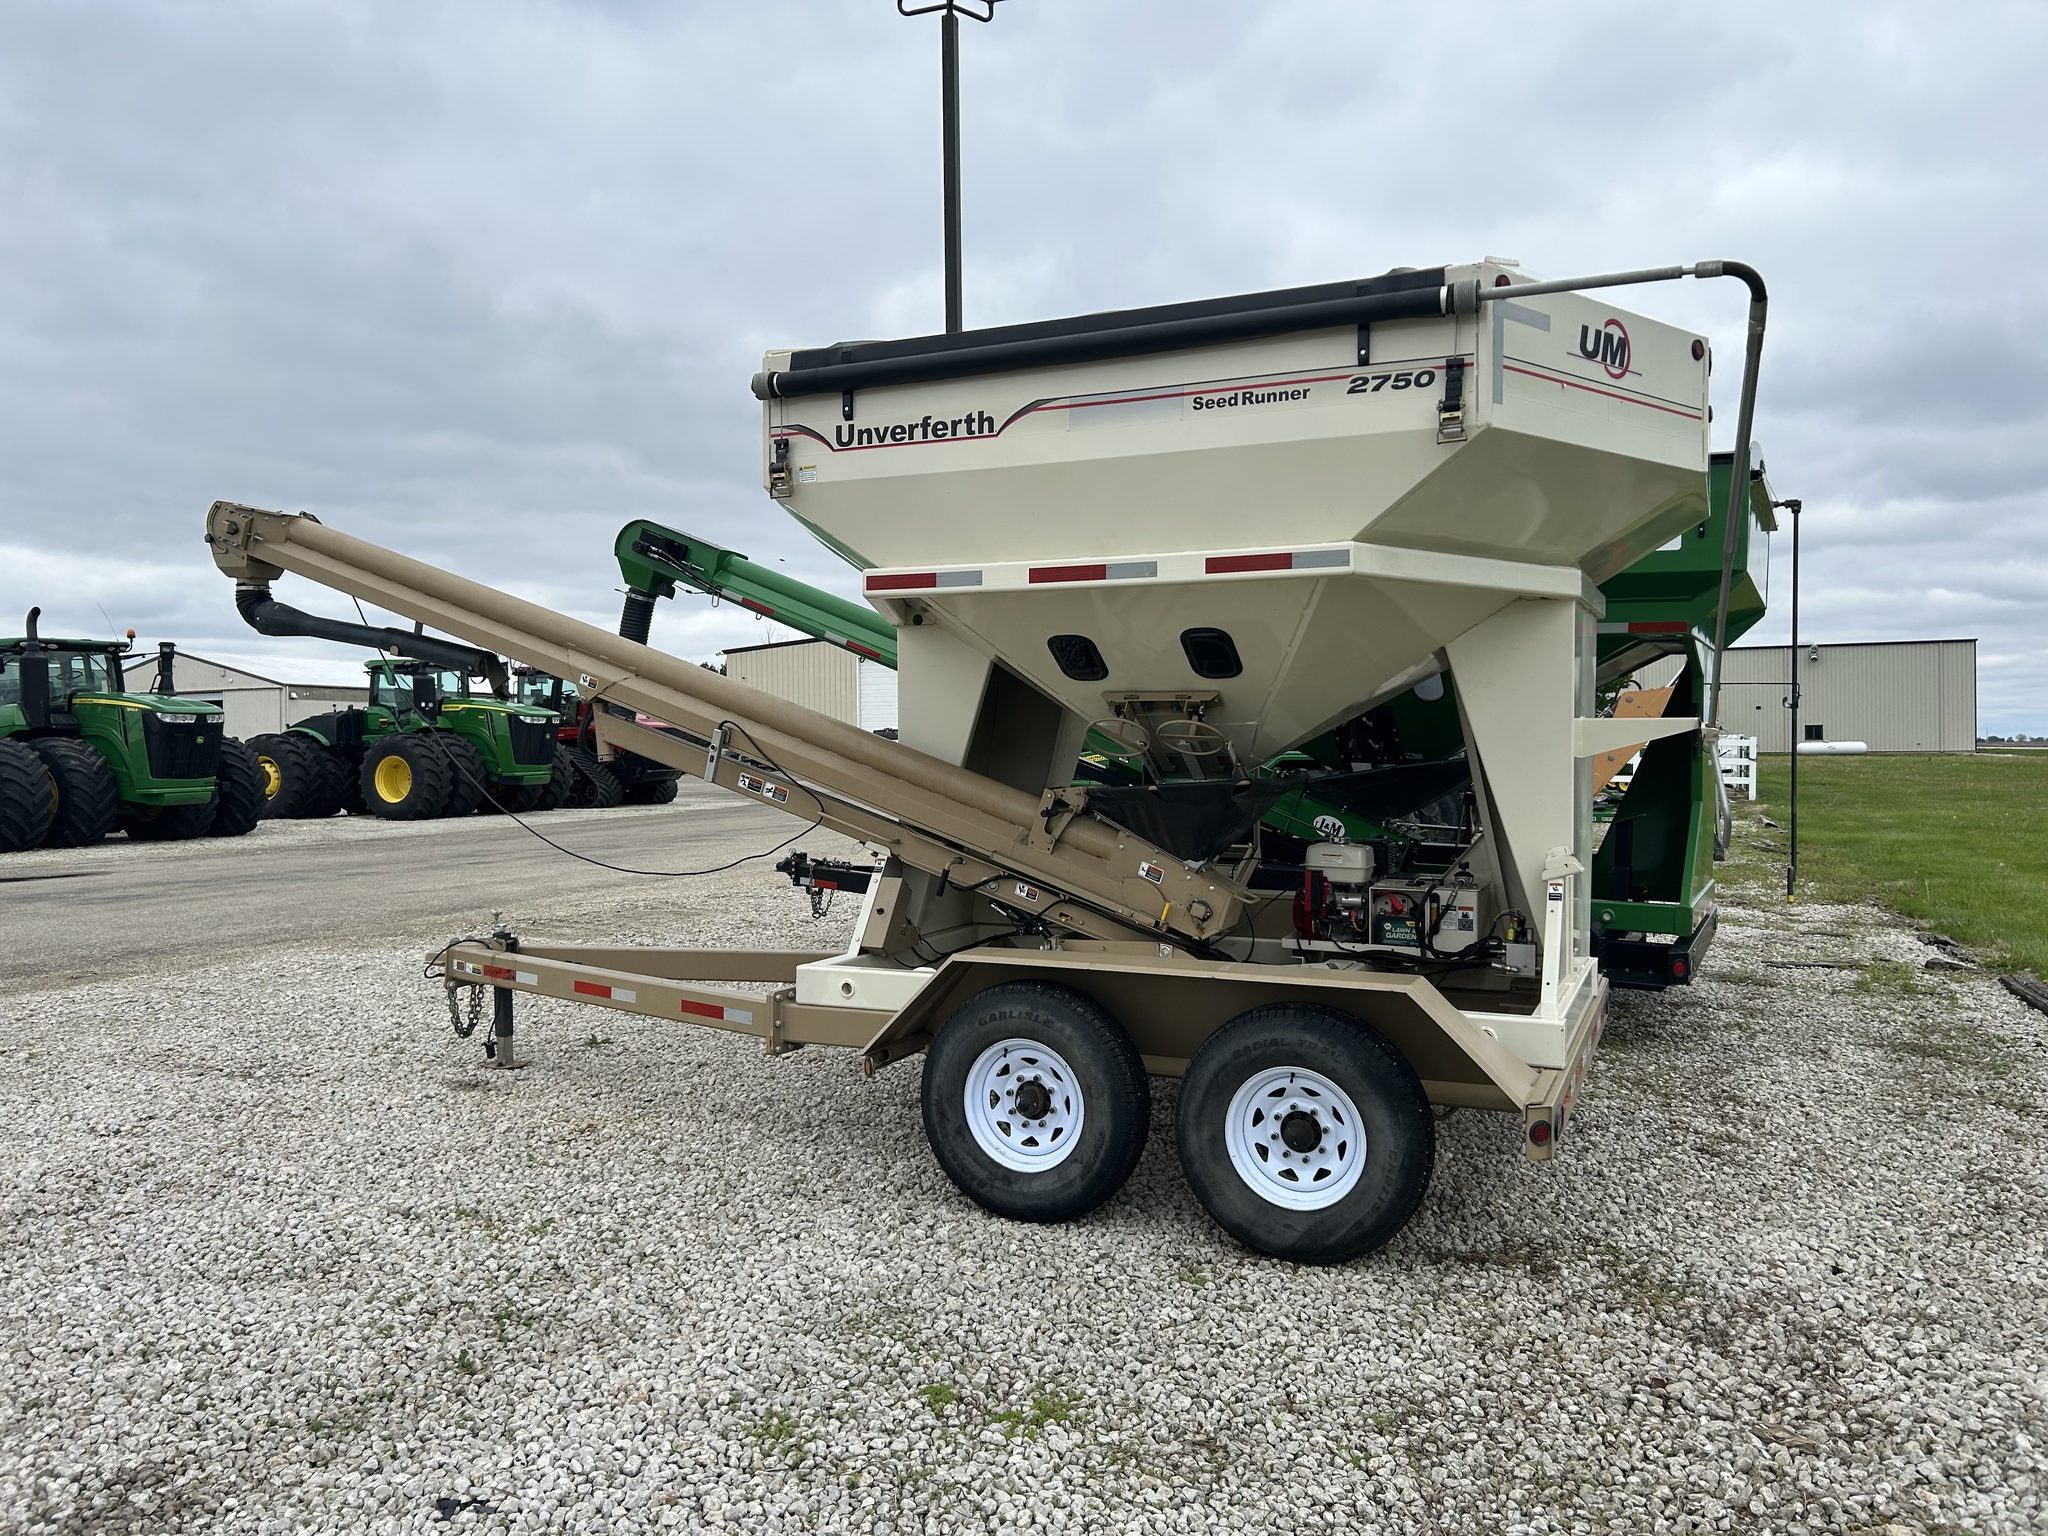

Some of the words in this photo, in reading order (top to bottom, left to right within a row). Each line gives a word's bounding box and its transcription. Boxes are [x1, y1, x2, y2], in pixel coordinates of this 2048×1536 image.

[1579, 323, 1627, 368] UM
[1346, 369, 1436, 395] 2750
[1192, 392, 1239, 411] Seed
[1241, 386, 1311, 406] Runner
[835, 410, 995, 448] Unverferth
[1385, 932, 1418, 940] GARDEN
[977, 1010, 1055, 1029] CARLISLE
[1232, 1037, 1290, 1060] RADIAL
